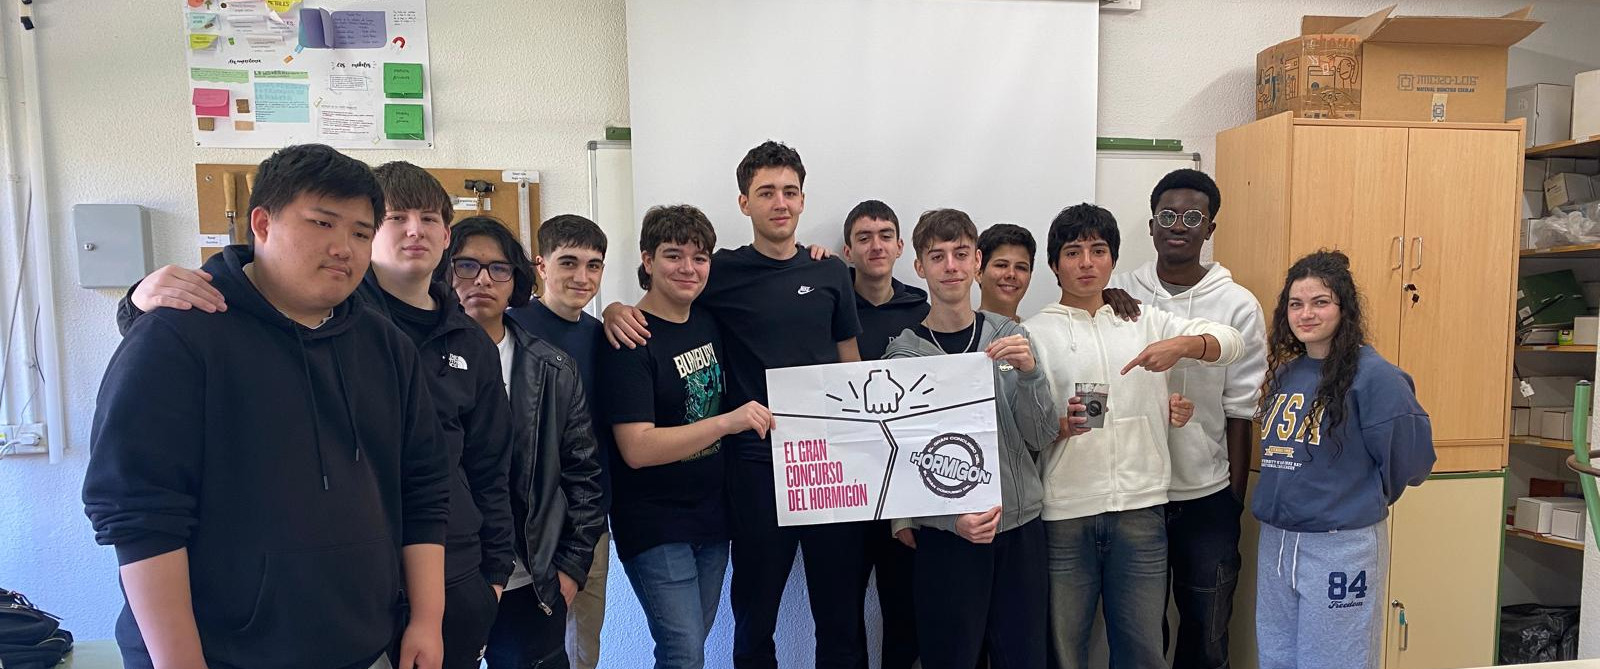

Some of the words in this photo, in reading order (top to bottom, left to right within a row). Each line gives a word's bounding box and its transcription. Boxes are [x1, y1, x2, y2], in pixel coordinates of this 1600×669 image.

[783, 441, 798, 464] EL
[798, 438, 828, 463] GRAN
[785, 460, 844, 488] CONCURSO
[787, 488, 808, 512] DEL
[809, 479, 868, 510] HORMIGÓN
[1328, 570, 1368, 600] 84
[1328, 600, 1364, 609] Freedom
